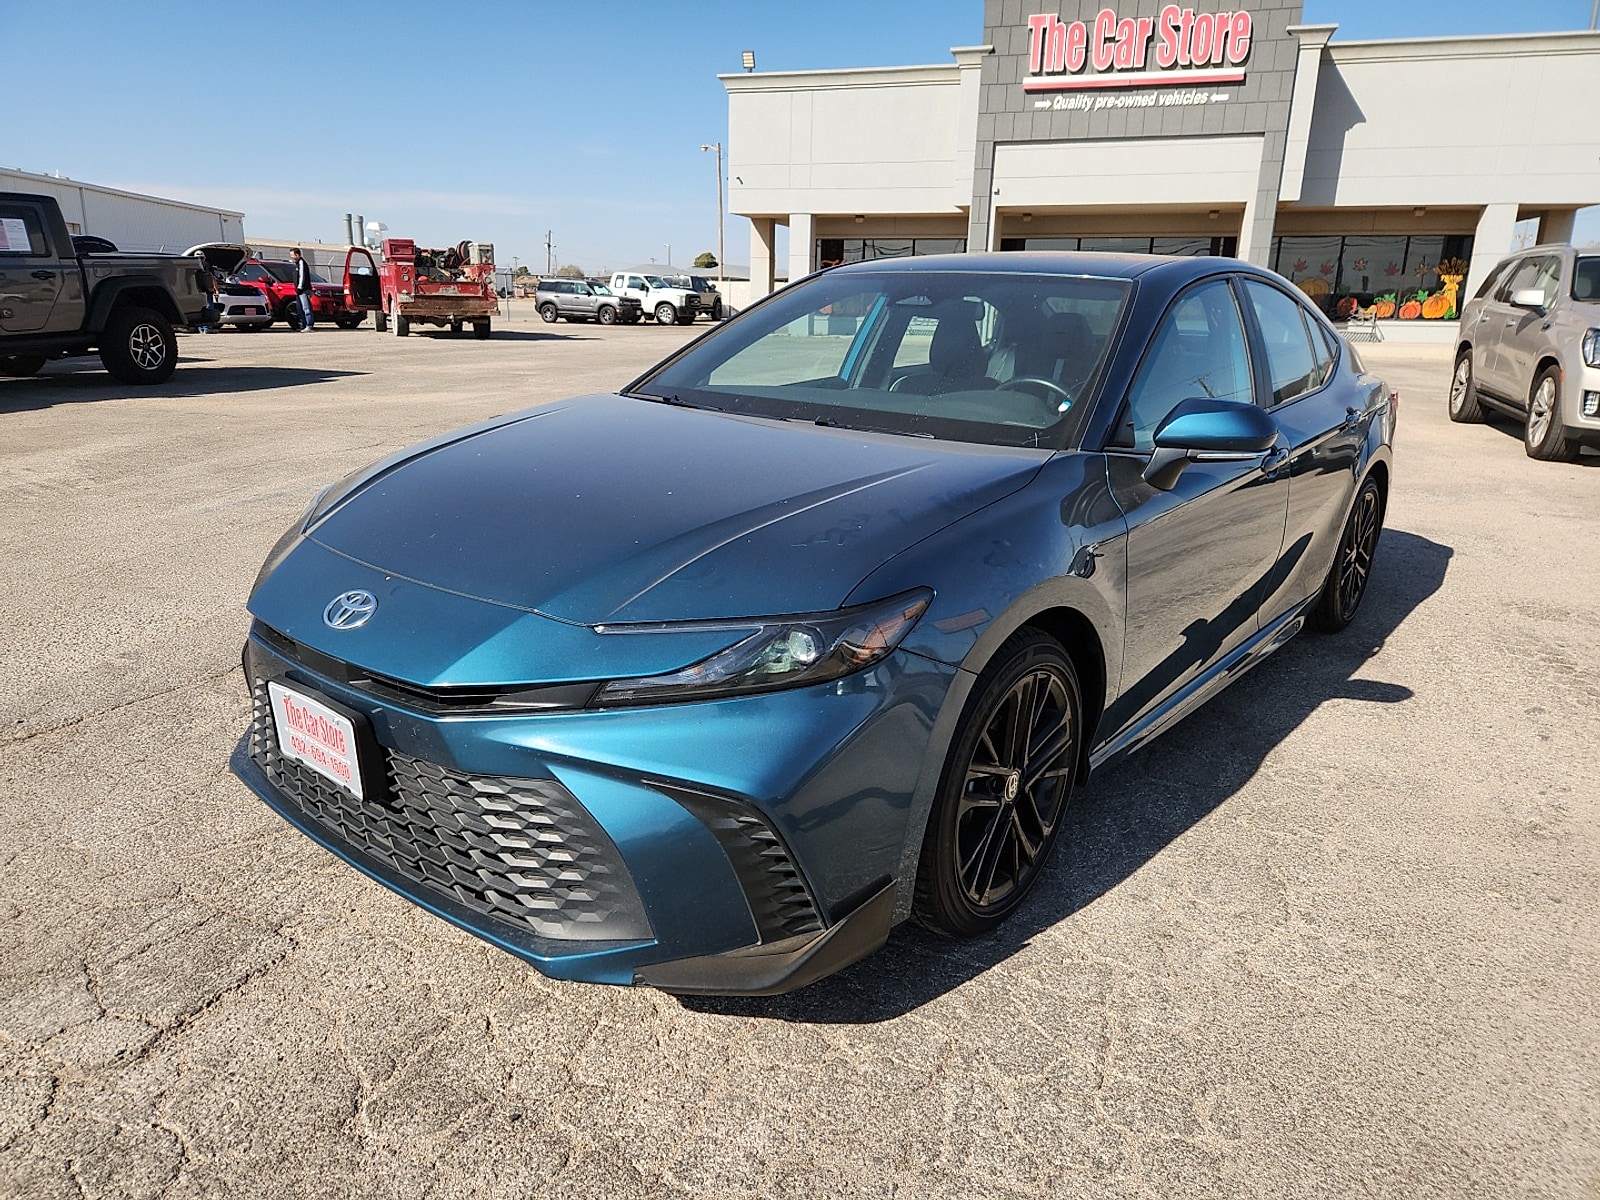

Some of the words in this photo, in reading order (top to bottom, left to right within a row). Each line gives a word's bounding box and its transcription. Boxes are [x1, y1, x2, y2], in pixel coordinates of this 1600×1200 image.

[1028, 14, 1086, 72] The
[1092, 9, 1153, 71] Car
[1156, 5, 1250, 68] Store
[1053, 95, 1094, 112] Quality
[1094, 92, 1157, 112] pre-owned
[1159, 90, 1209, 106] vehicles
[283, 697, 303, 729] The
[302, 706, 319, 738] Car
[318, 715, 346, 755] Store
